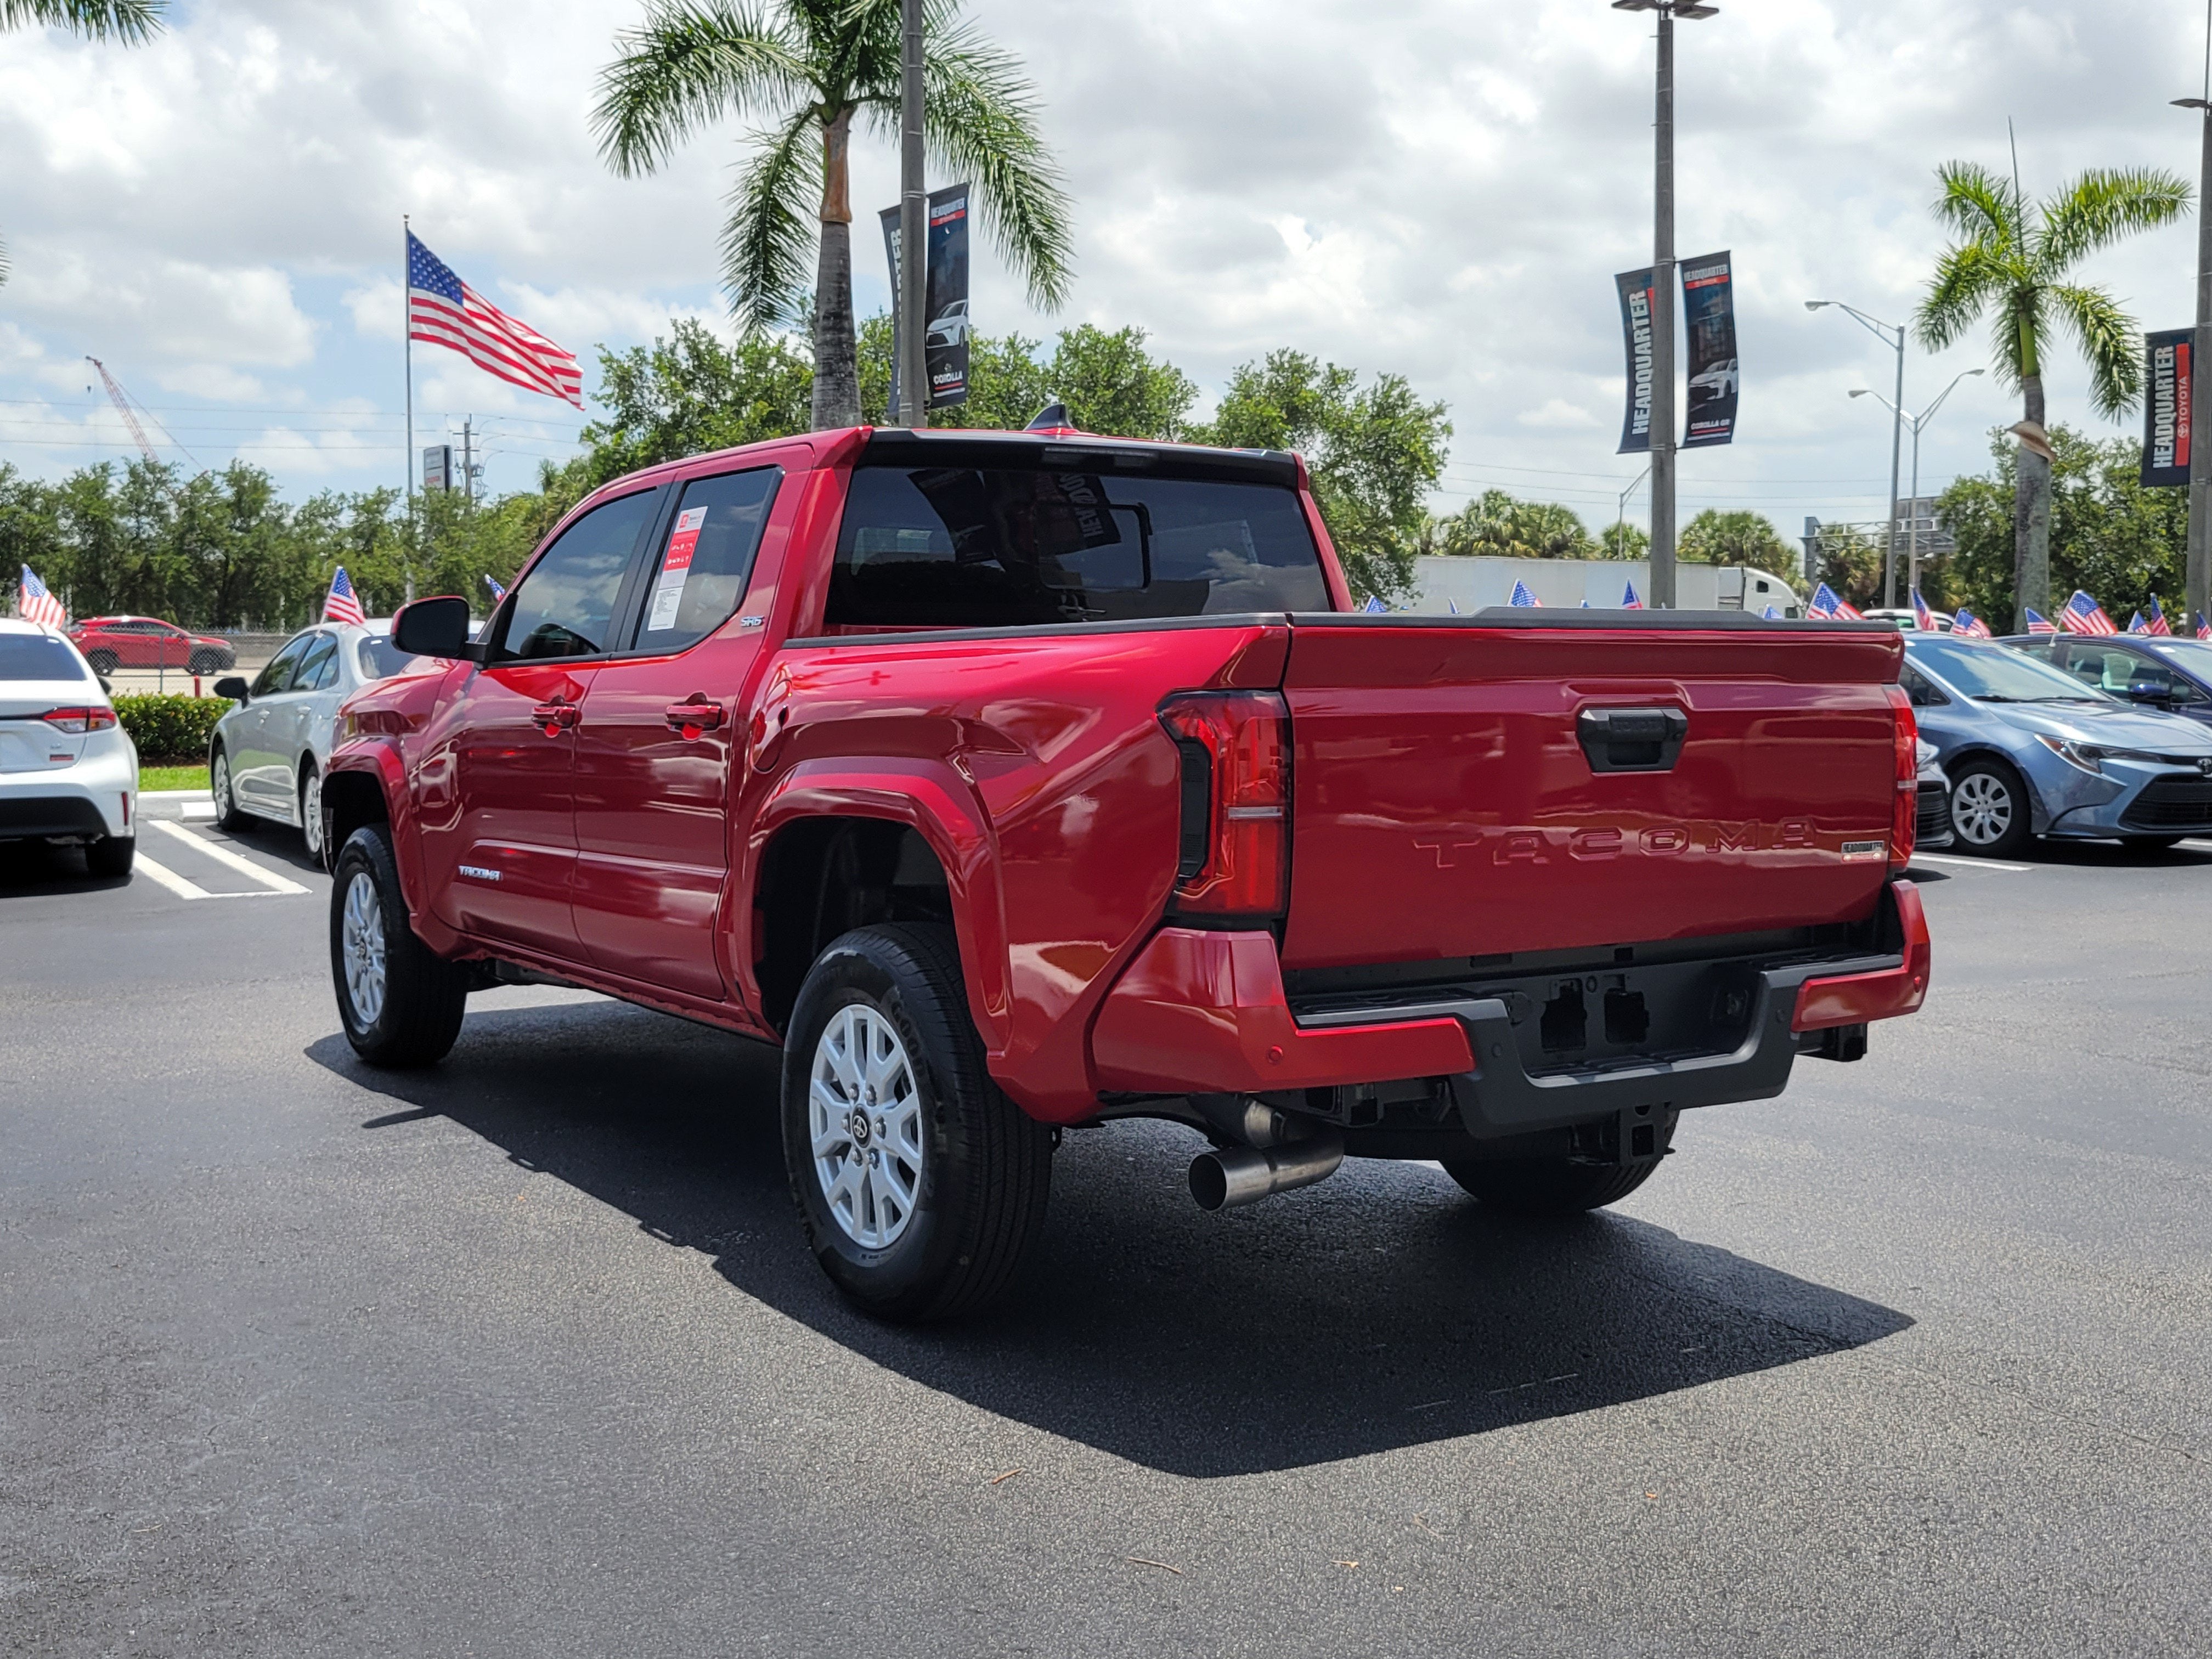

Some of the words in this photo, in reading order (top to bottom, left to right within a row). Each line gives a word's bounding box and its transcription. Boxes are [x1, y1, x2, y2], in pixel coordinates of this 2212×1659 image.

[1629, 290, 1652, 435] HEADQUARTER
[2153, 345, 2177, 468] HEADQUARTER
[2178, 376, 2188, 422] TOYOTA
[1413, 816, 1818, 868] TACOMA
[459, 865, 500, 881] TACOMA
